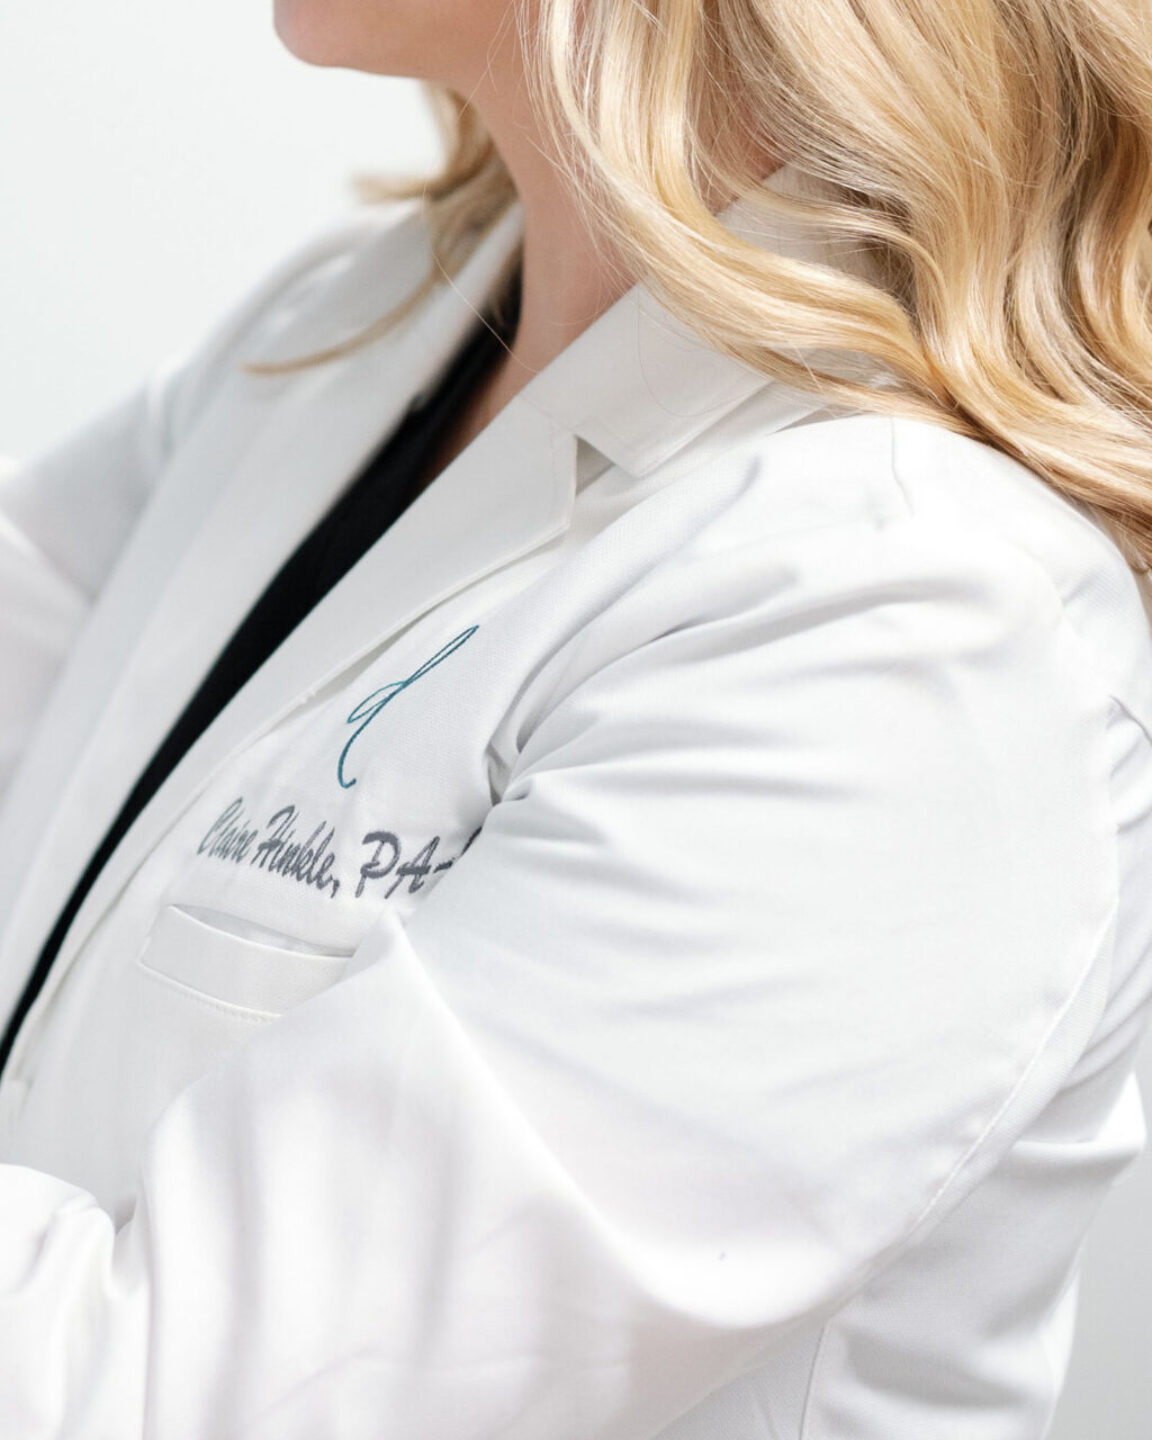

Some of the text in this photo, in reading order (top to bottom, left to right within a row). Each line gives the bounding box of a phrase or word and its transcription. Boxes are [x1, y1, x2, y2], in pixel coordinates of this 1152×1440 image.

[198, 796, 483, 900] Claire Hinkle, PA-
